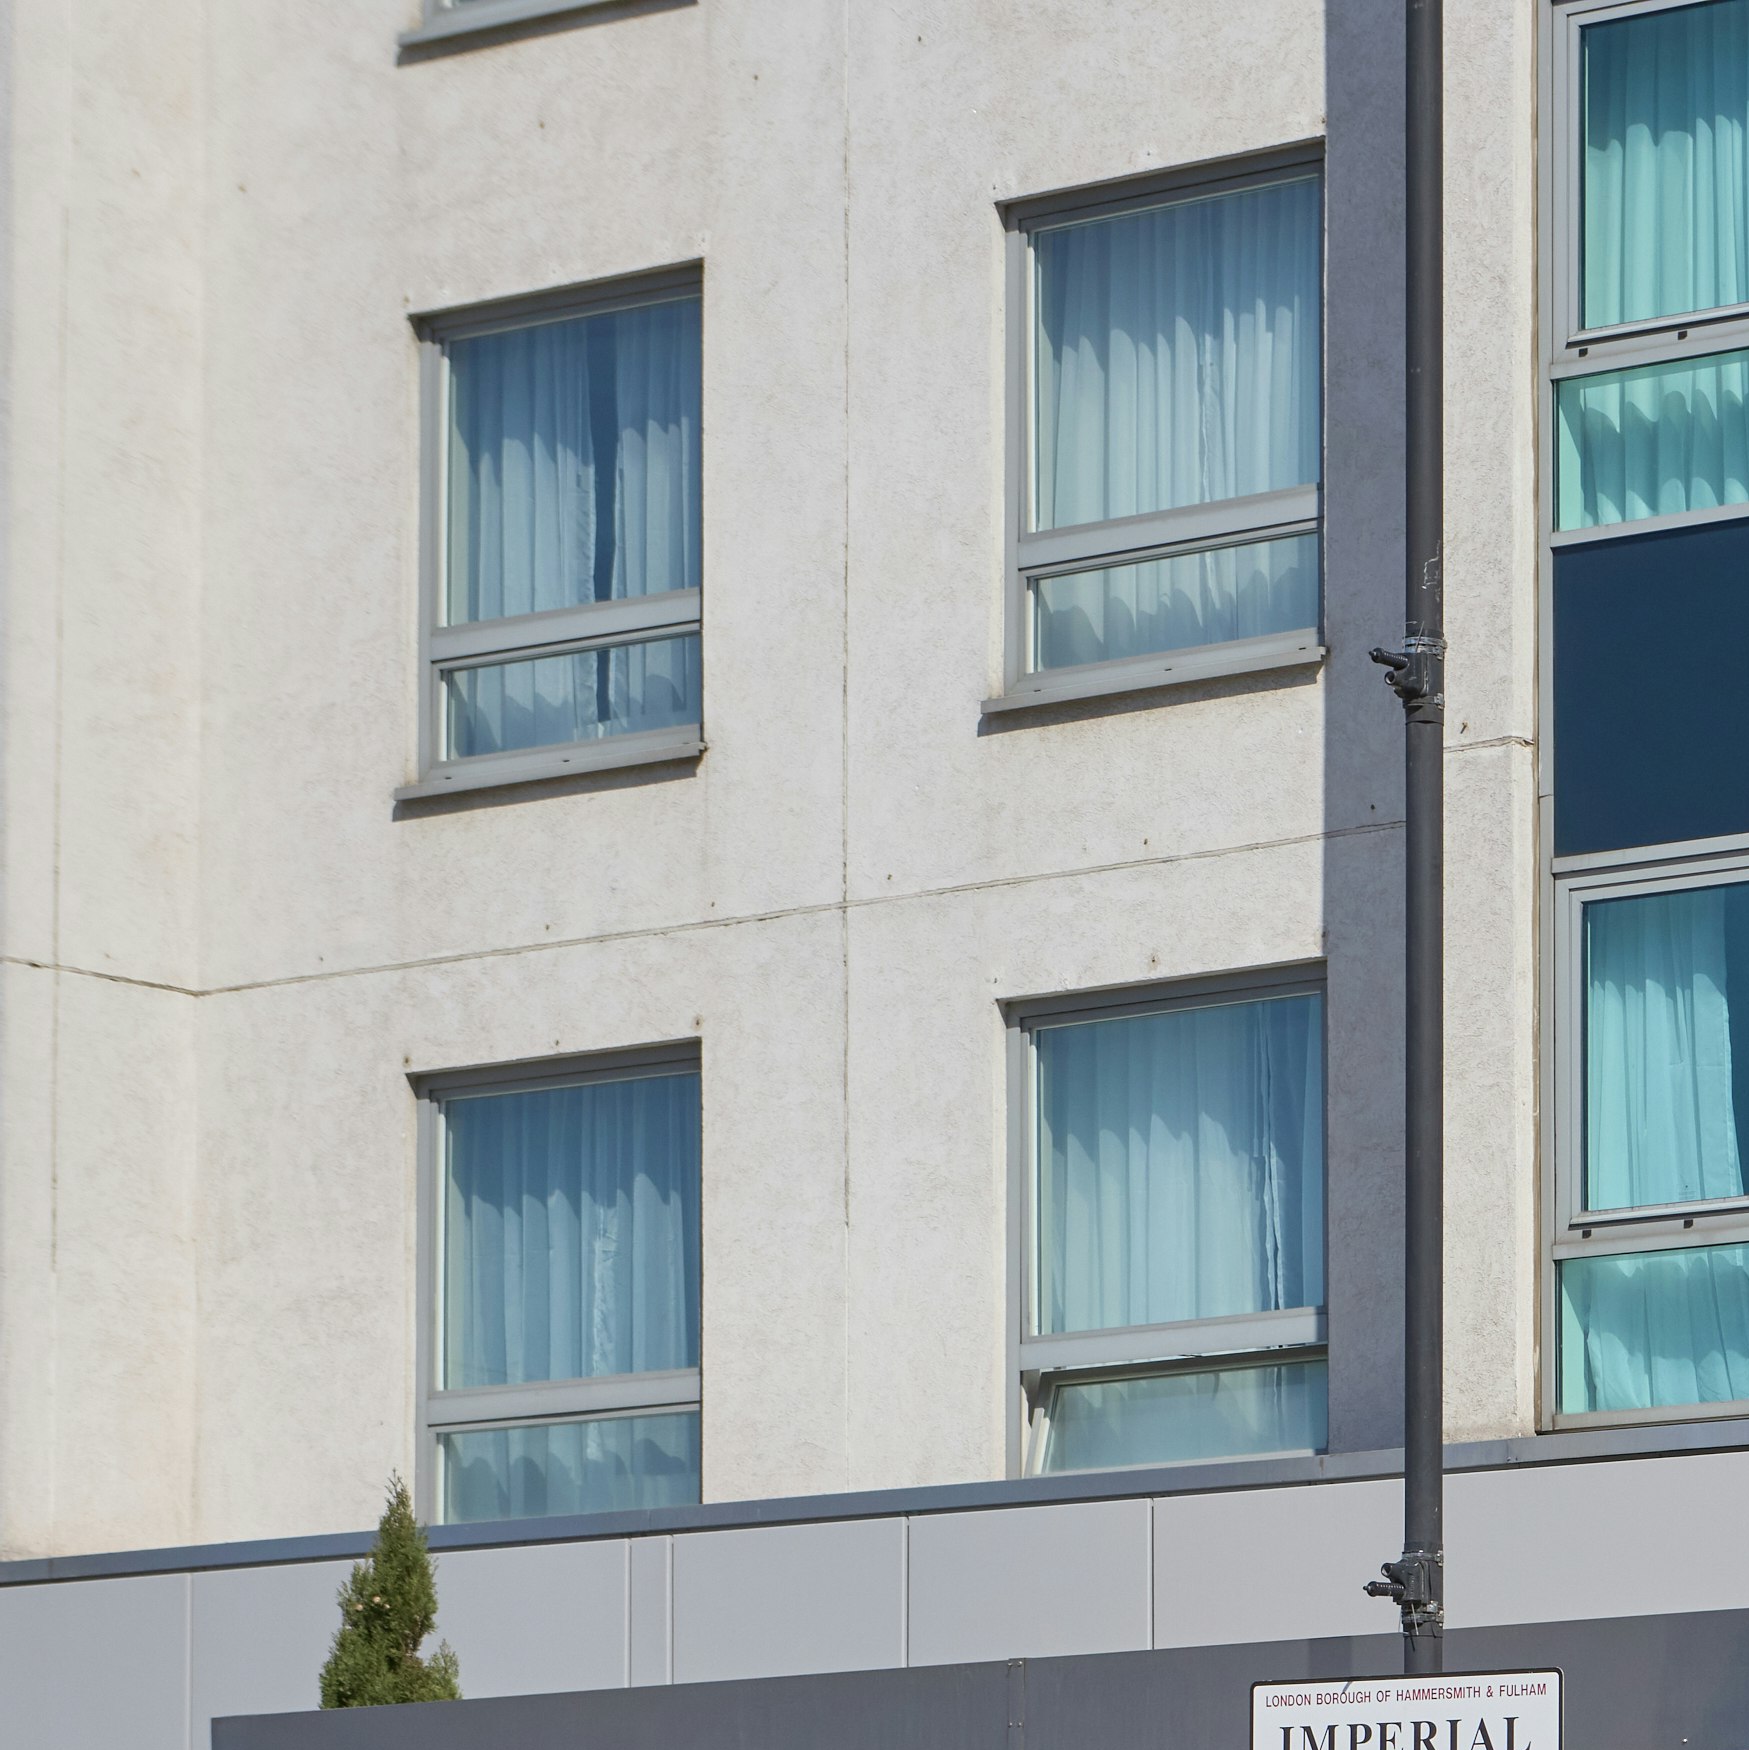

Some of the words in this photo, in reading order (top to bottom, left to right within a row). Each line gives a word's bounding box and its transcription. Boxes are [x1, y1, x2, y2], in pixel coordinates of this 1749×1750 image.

[1266, 1694, 1311, 1708] LONDON
[1316, 1692, 1371, 1705] BOROUGH
[1376, 1690, 1391, 1702] OF
[1396, 1686, 1481, 1702] HAMMERSMITH
[1486, 1686, 1494, 1698] &
[1499, 1683, 1547, 1697] FULHAM
